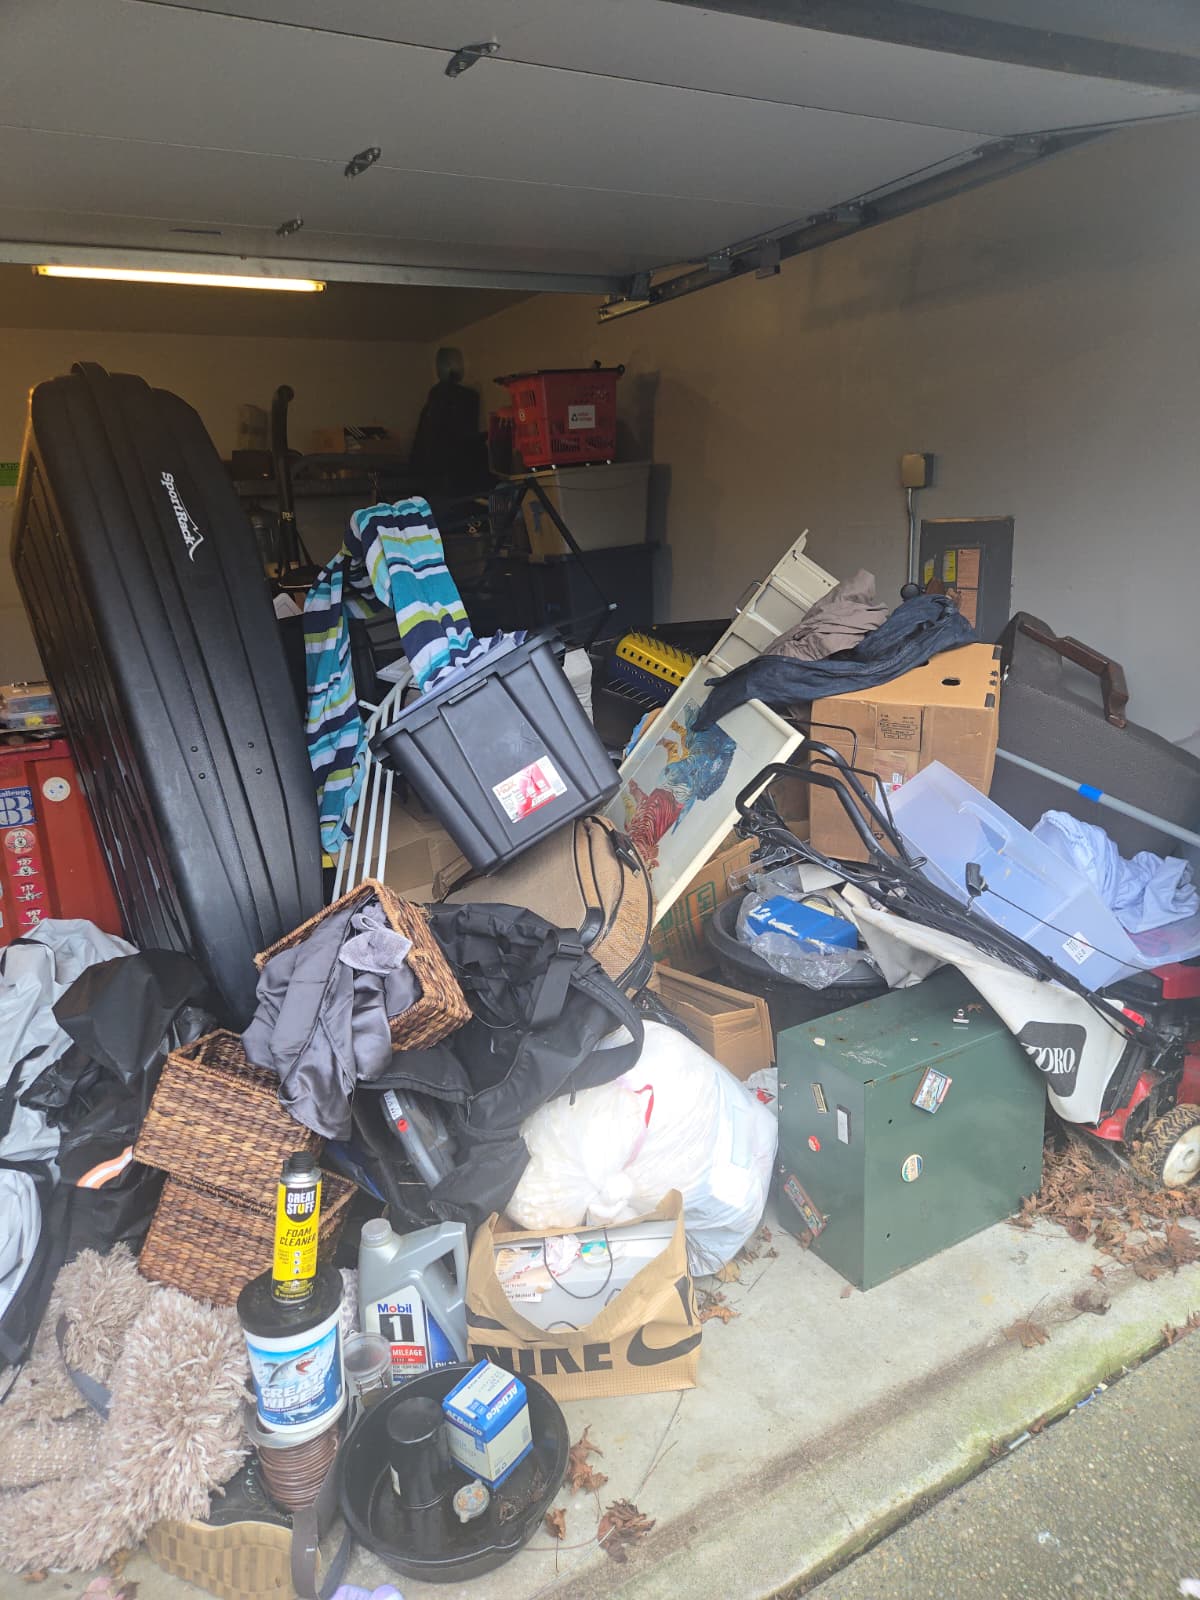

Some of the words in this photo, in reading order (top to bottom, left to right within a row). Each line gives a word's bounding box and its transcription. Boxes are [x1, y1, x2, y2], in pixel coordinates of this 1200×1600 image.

[160, 471, 196, 547] SportRack
[287, 1202, 314, 1215] STUFF
[288, 1190, 315, 1204] GREAT
[280, 1233, 317, 1247] CLEANER
[286, 1227, 312, 1239] FOAM
[377, 1303, 413, 1313] Mobil
[388, 1315, 404, 1341] 1
[392, 1348, 423, 1357] MILEAGE
[471, 1342, 613, 1376] NIKE
[261, 1368, 324, 1399] GREAT
[262, 1382, 326, 1409] WIPES
[485, 1383, 519, 1421] ACDelco
[445, 1409, 483, 1437] ACDelco
